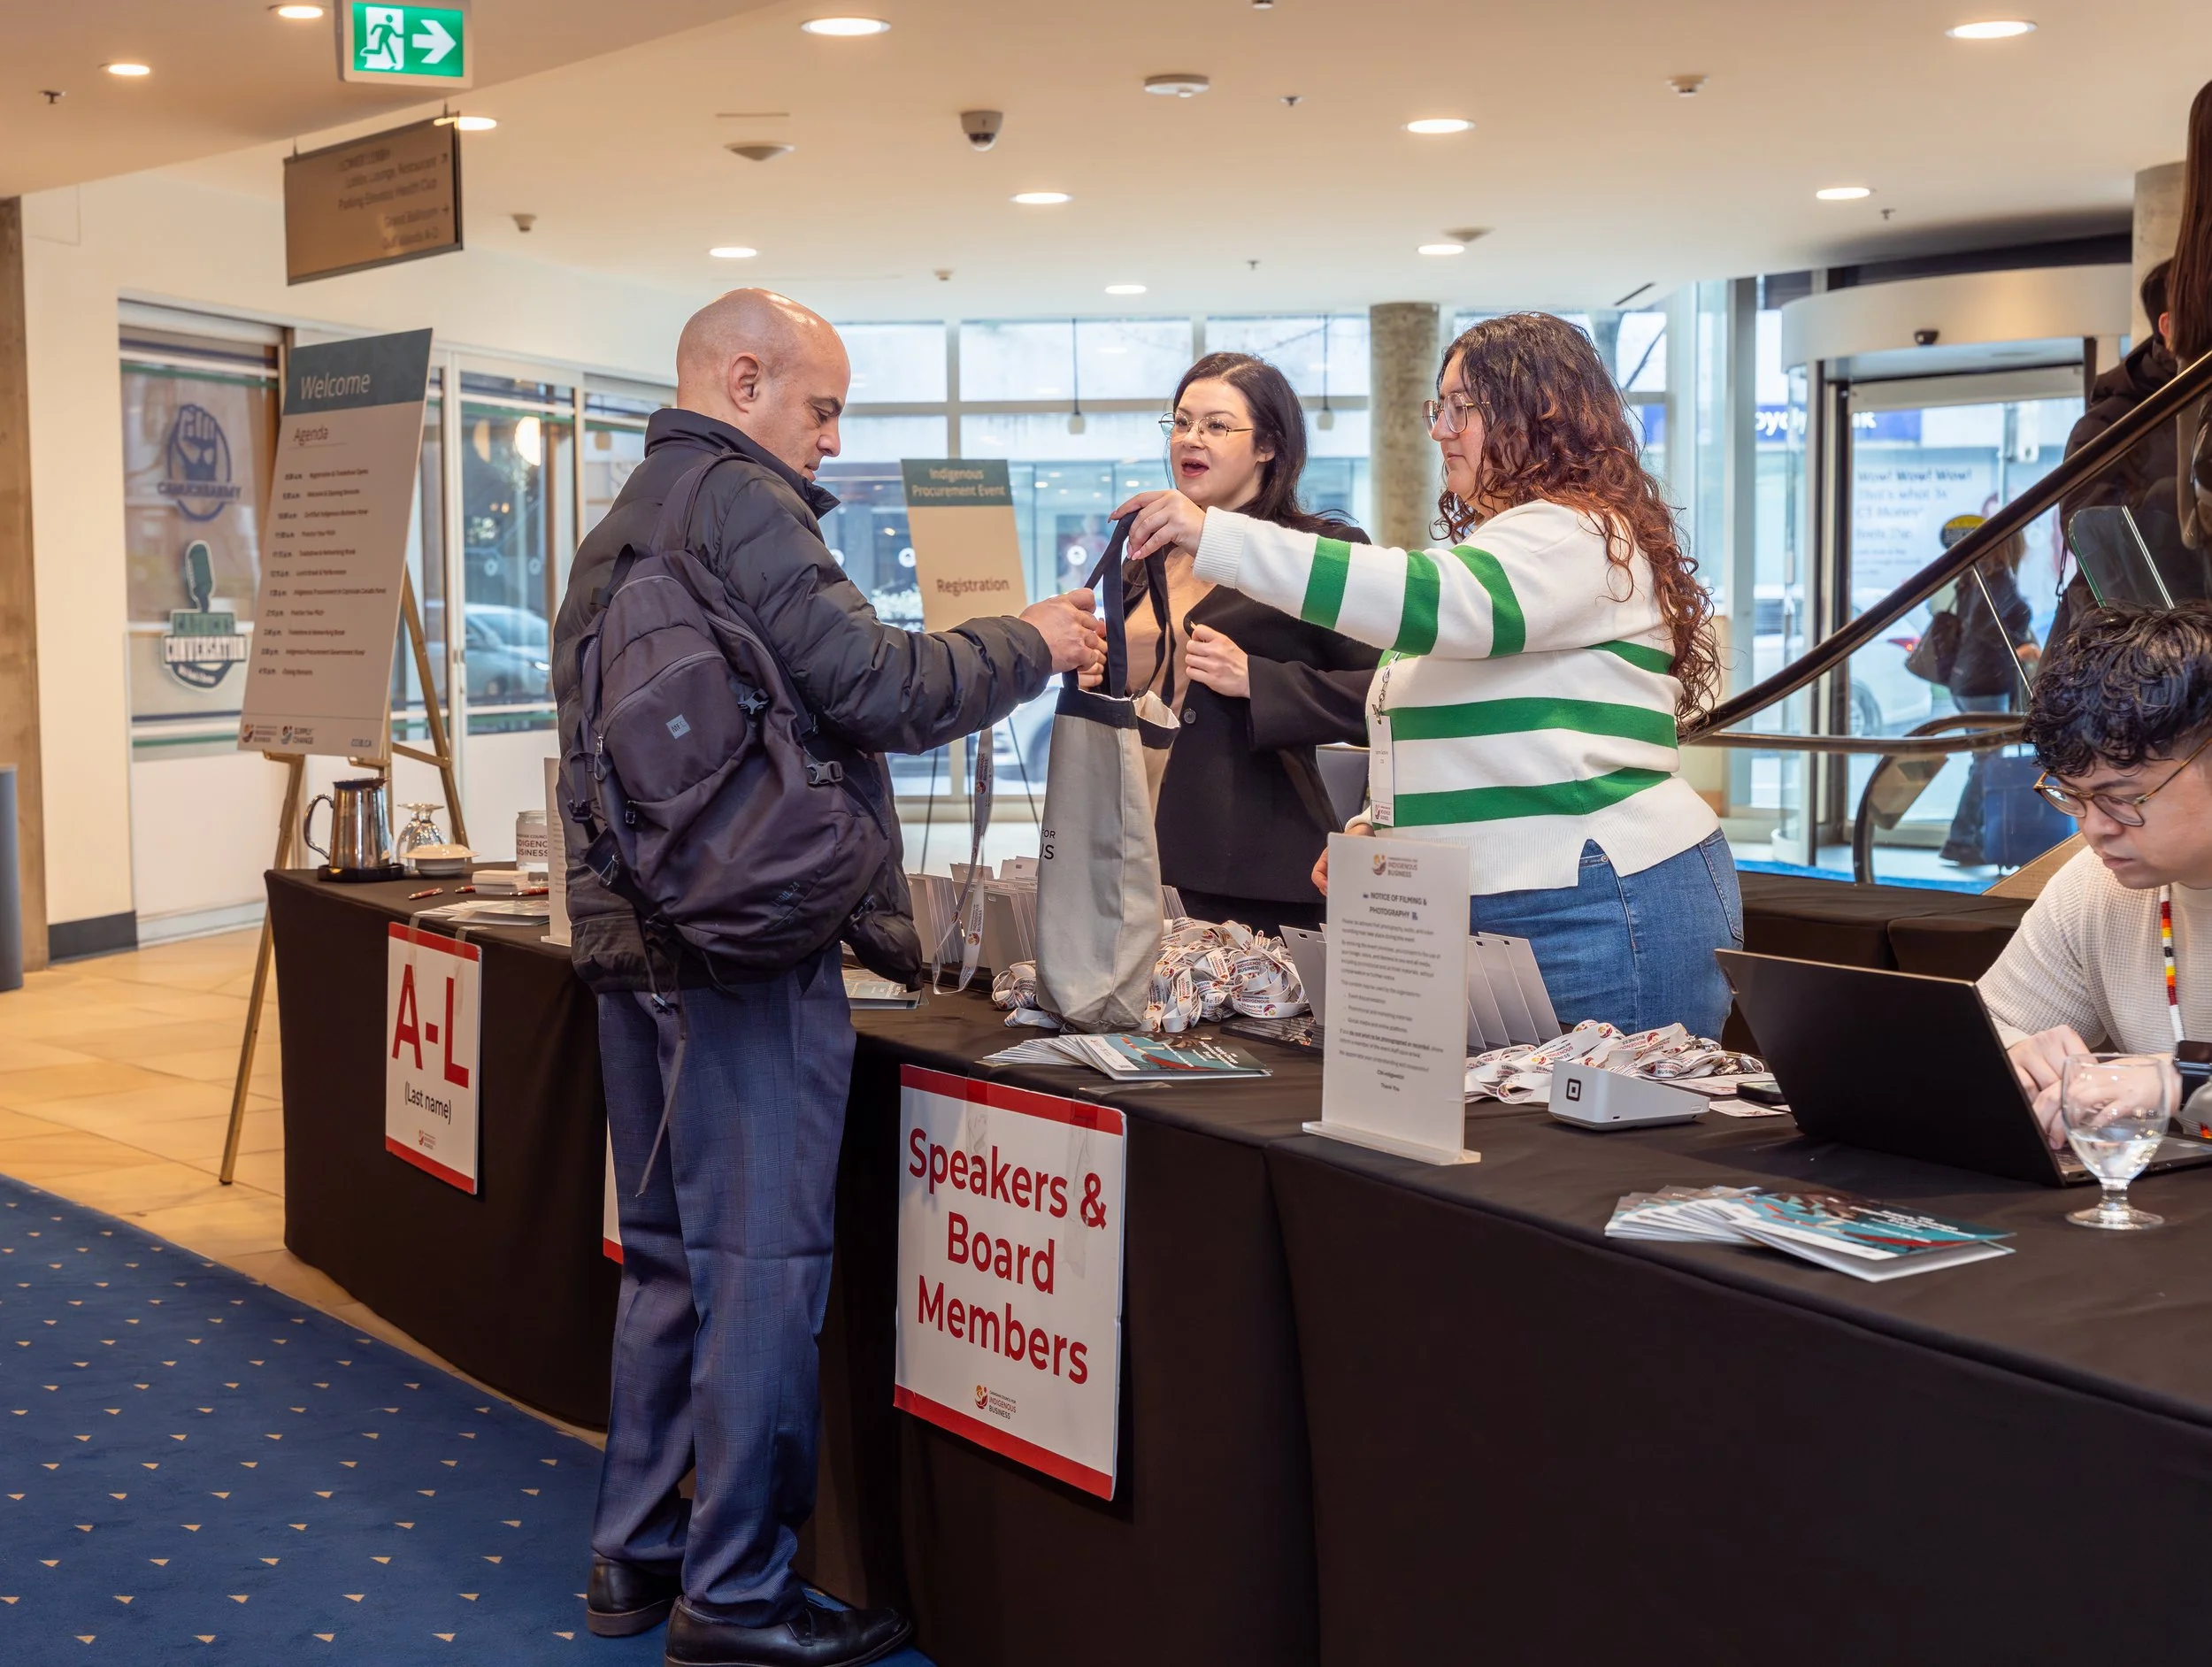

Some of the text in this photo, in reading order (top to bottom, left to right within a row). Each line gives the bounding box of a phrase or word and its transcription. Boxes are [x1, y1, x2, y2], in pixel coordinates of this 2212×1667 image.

[301, 372, 371, 400] Welcome
[293, 423, 329, 446] Agenda
[929, 467, 985, 482] Indigenous
[911, 484, 1006, 497] Procurement Event
[936, 577, 1010, 597] Registration
[1387, 861, 1417, 871] INDIGENOUS
[1371, 892, 1391, 902] NOTICE
[1399, 896, 1422, 905] FILMING
[1370, 906, 1410, 918] PHOTOGRAPHY
[392, 964, 469, 1089] A-L
[404, 1081, 452, 1125] (Last name)
[909, 1127, 1107, 1231] Speakers &
[948, 1210, 1056, 1295] Board
[918, 1274, 1088, 1385] Members
[988, 1404, 1011, 1420] BUSINESS
[989, 1396, 1017, 1413] INDIGENOUS
